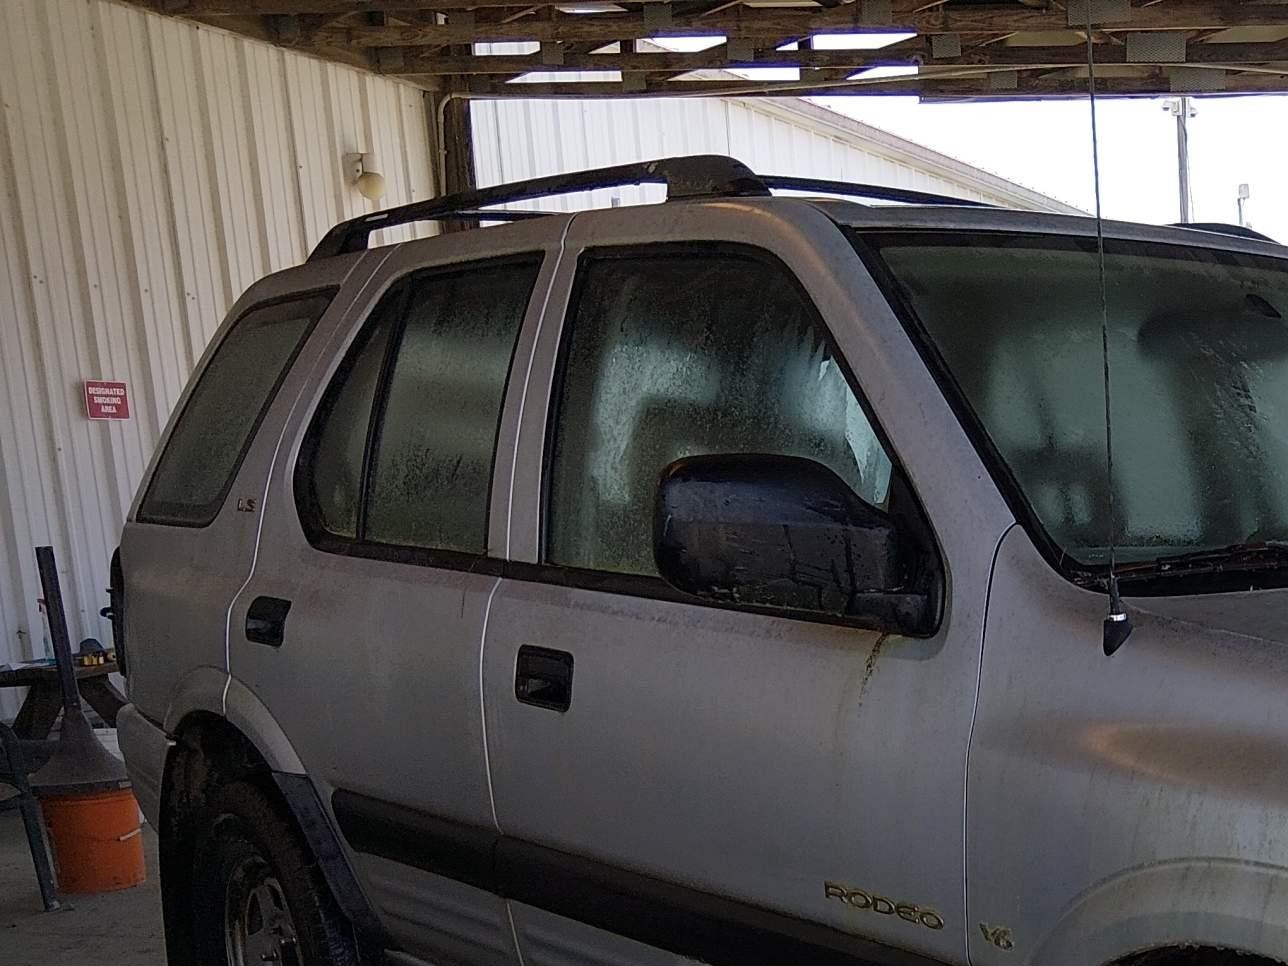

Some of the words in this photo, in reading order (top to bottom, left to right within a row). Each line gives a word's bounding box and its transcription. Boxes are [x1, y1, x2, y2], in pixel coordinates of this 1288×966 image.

[88, 386, 125, 396] DESIGNATED
[94, 396, 122, 405] SMOKING
[101, 405, 117, 413] AREA
[237, 498, 256, 512] LS
[824, 880, 944, 931] RODEO
[979, 923, 1015, 951] V6
